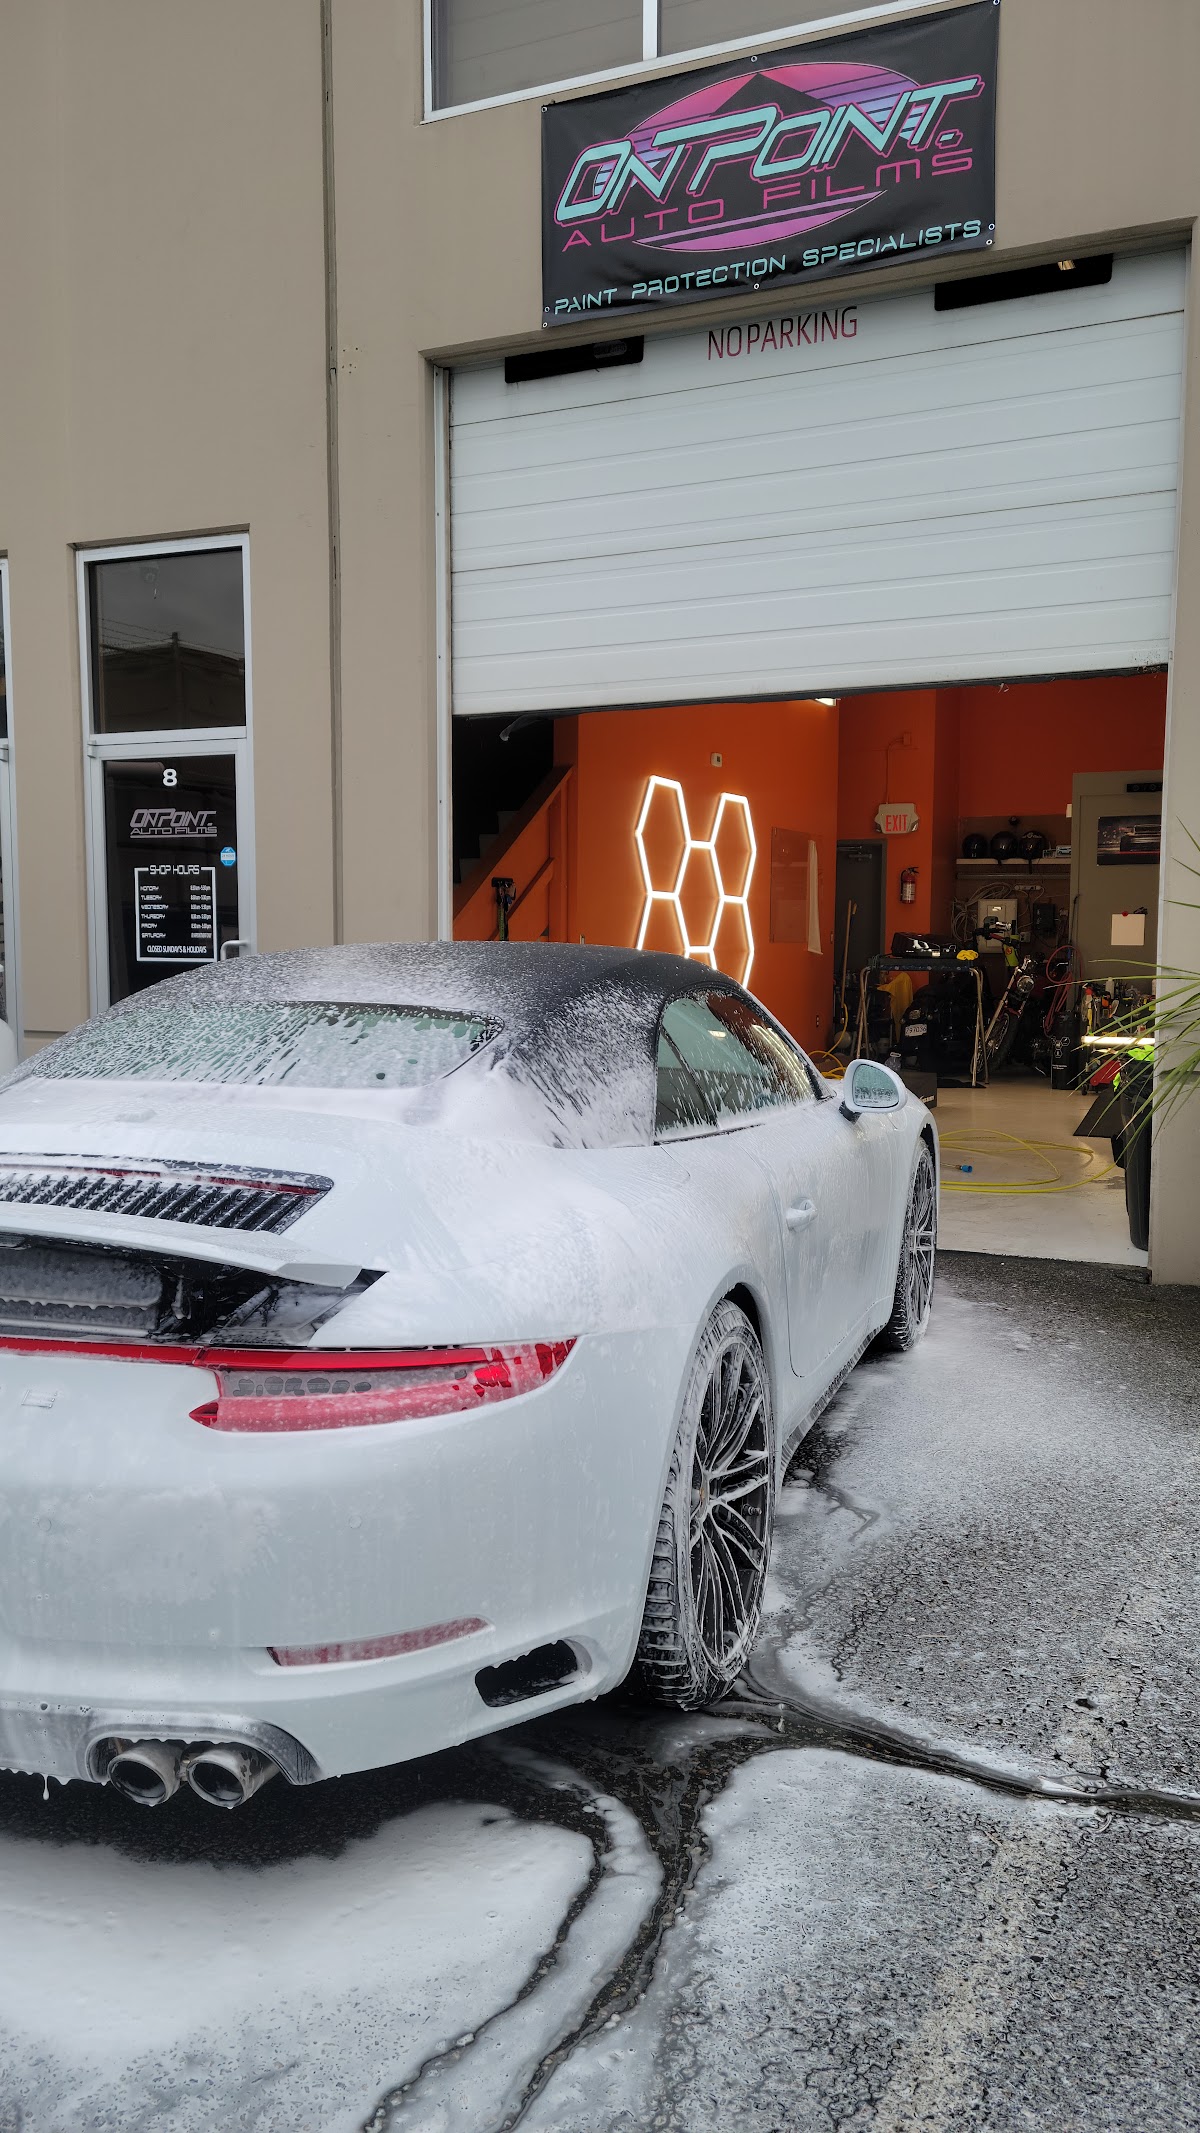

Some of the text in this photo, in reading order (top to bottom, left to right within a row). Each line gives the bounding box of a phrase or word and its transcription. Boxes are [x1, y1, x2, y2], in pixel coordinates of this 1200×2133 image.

[562, 148, 974, 252] AUTO FILMS
[554, 219, 982, 315] PAINT PROTECTION SPECIALISTS
[162, 768, 178, 787] 8
[885, 814, 908, 832] EXIT
[149, 864, 200, 875] SHOP HOURS
[147, 945, 162, 953] CLOSED
